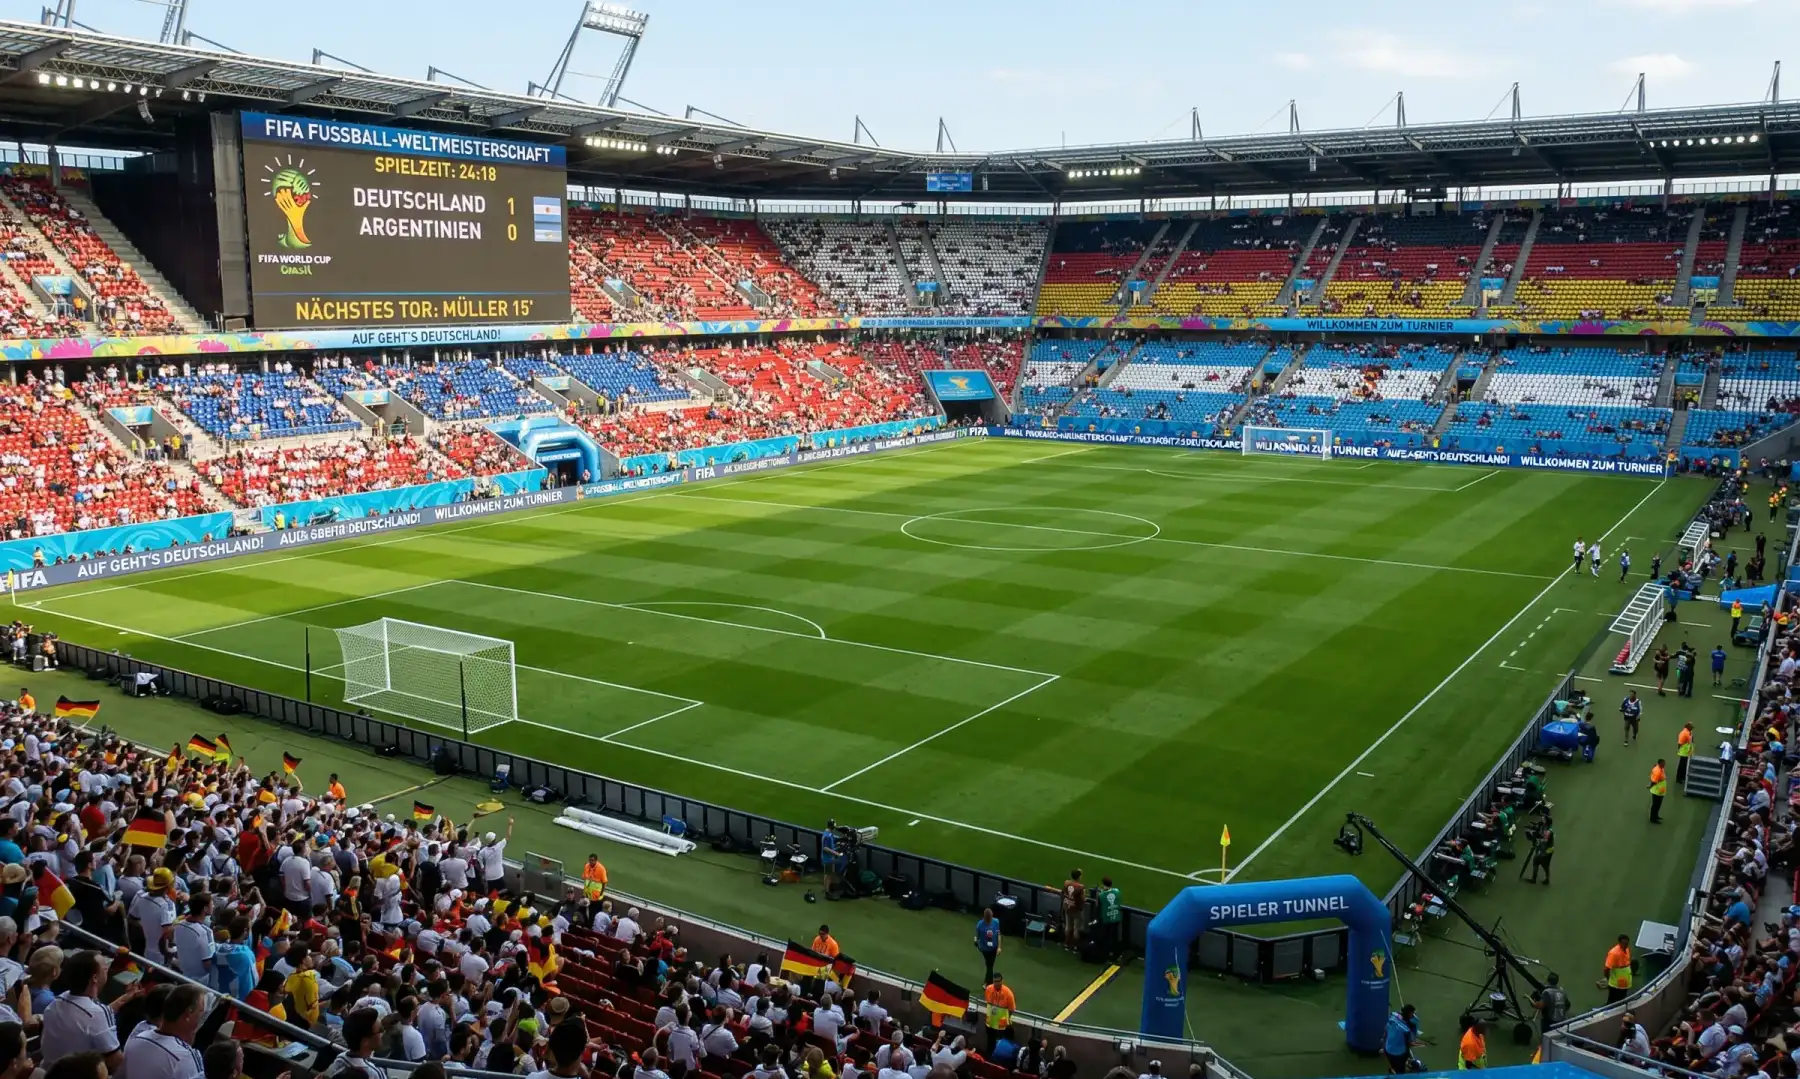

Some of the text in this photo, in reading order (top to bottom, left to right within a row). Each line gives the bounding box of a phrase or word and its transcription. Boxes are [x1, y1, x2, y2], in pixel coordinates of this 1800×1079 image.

[265, 119, 551, 163] FIFA FUSSBALL-WELTMEISTERSCHAFT
[375, 157, 497, 182] SPIELZEIT: 24:18
[353, 187, 515, 215] DEUTSCHLAND 1
[359, 217, 518, 241] ARGENTINIEN 0
[258, 254, 332, 264] FIFA WORLD CUP
[296, 298, 395, 321] NÄCHSTES
[399, 300, 439, 319] TOR:
[443, 296, 509, 317] MÜLLER
[352, 328, 501, 345] AUF GEHT'S DEUTSCHLAND!
[1307, 320, 1454, 331] WILLKOMMEN ZUM TURNIER
[1333, 445, 1378, 457] TURNIER
[695, 467, 716, 480] FIFA
[1521, 456, 1664, 474] WILLKOMMEN ZUM TURNIER
[434, 490, 563, 521] WILLKOMMEN ZUM TURNIER
[77, 536, 265, 578] AUF GEHT'S DEUTSCHLAND!
[1209, 895, 1350, 920] SPIELER TUNNEL
